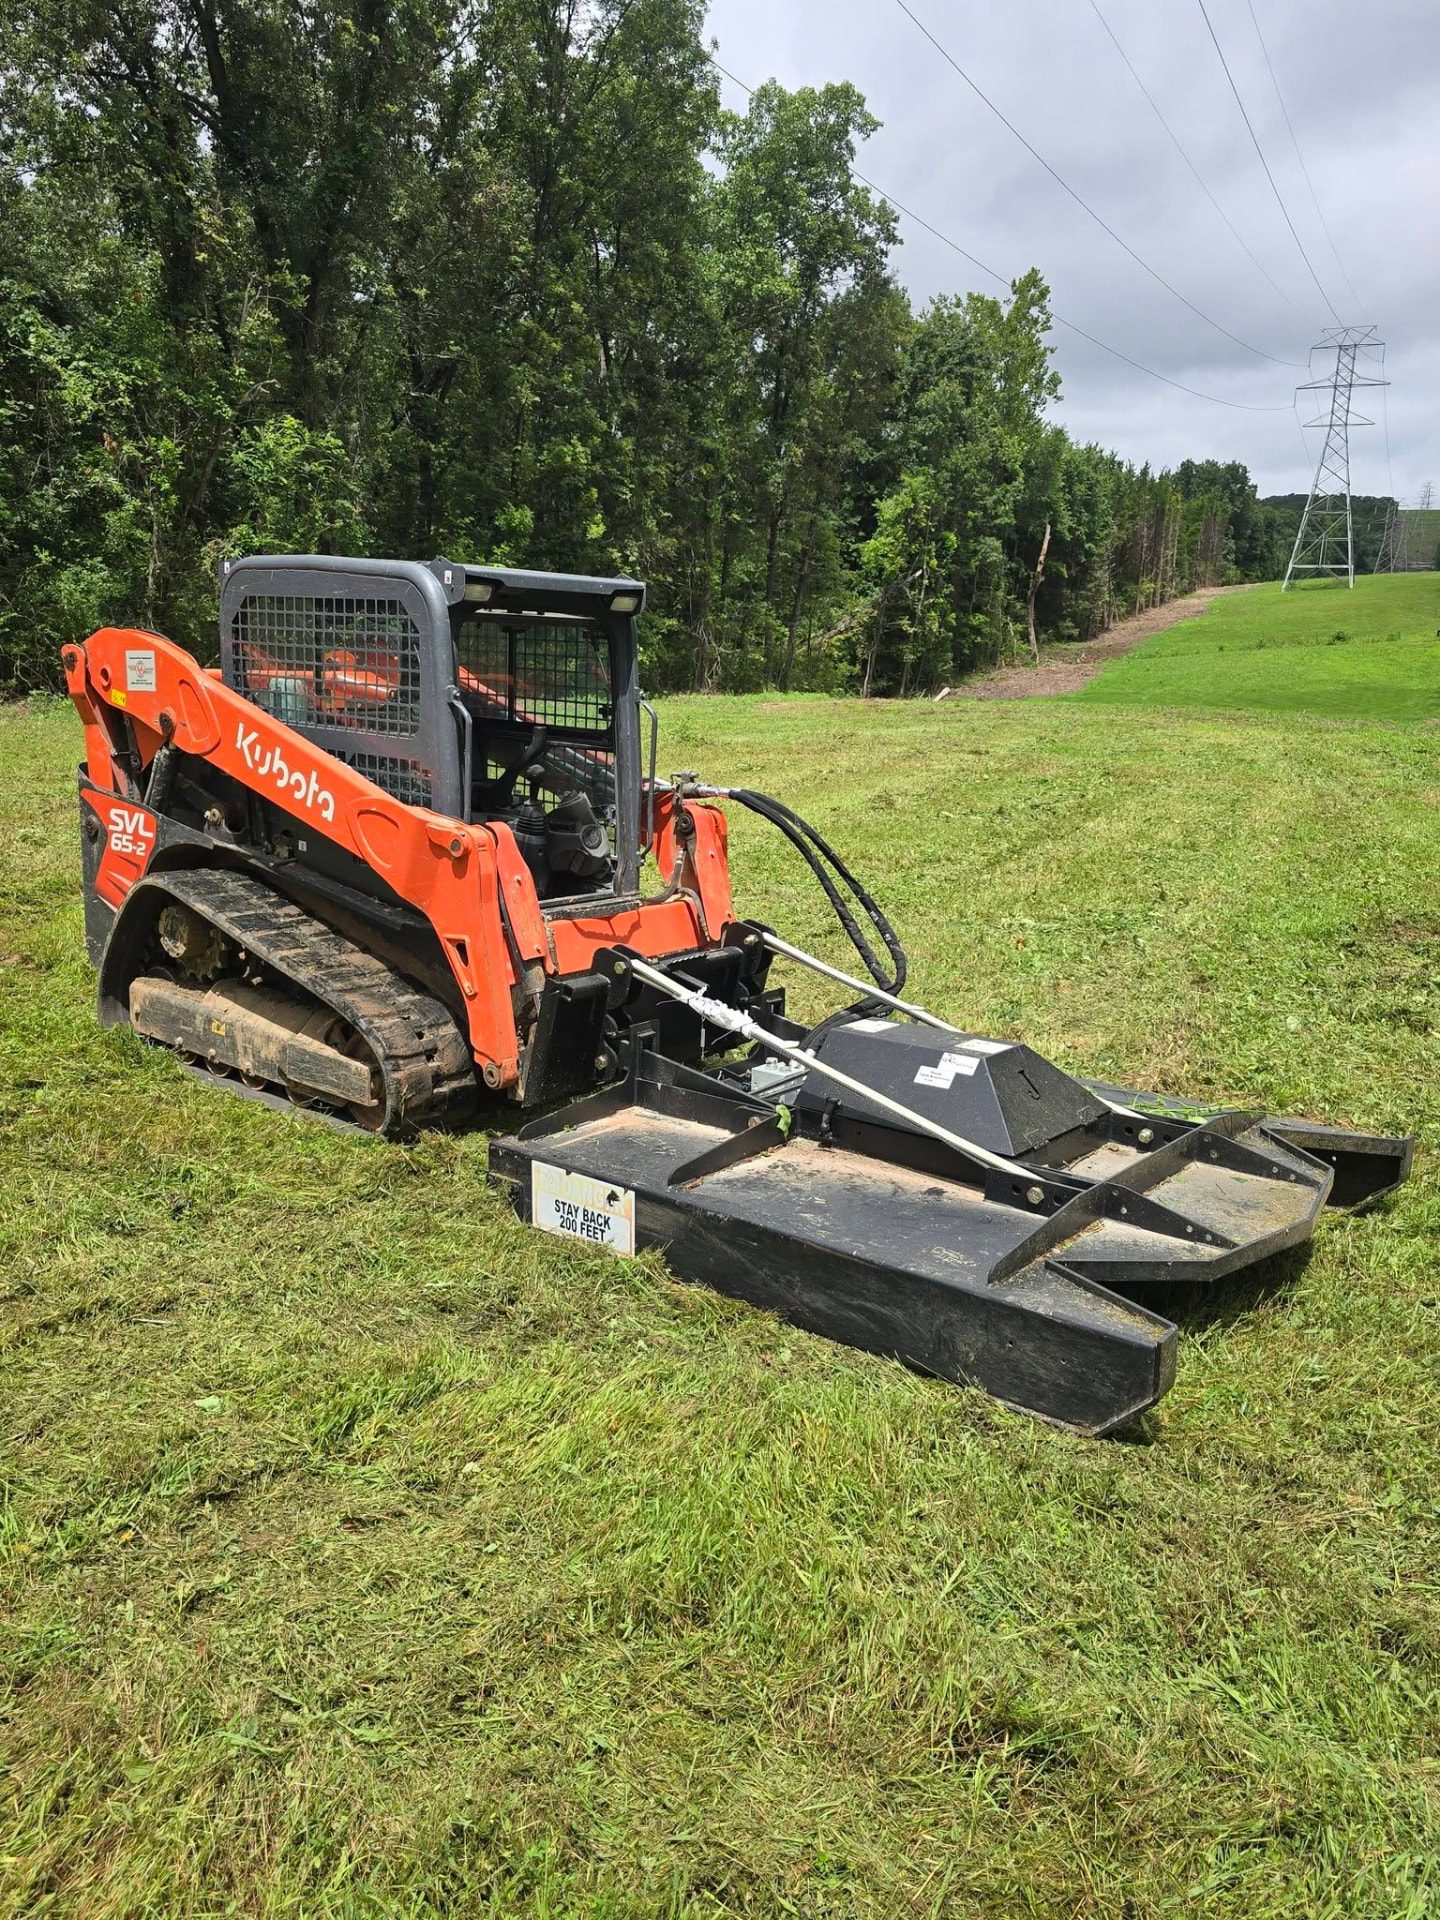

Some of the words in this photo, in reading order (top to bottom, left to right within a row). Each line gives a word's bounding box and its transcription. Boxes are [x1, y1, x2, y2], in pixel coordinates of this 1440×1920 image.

[235, 722, 335, 823] Kubota
[108, 808, 153, 838] SVL
[111, 833, 146, 856] 65-2
[554, 1199, 579, 1217] STAY
[583, 1207, 611, 1230] BACK
[560, 1216, 577, 1233] 200
[580, 1223, 606, 1242] FEET
